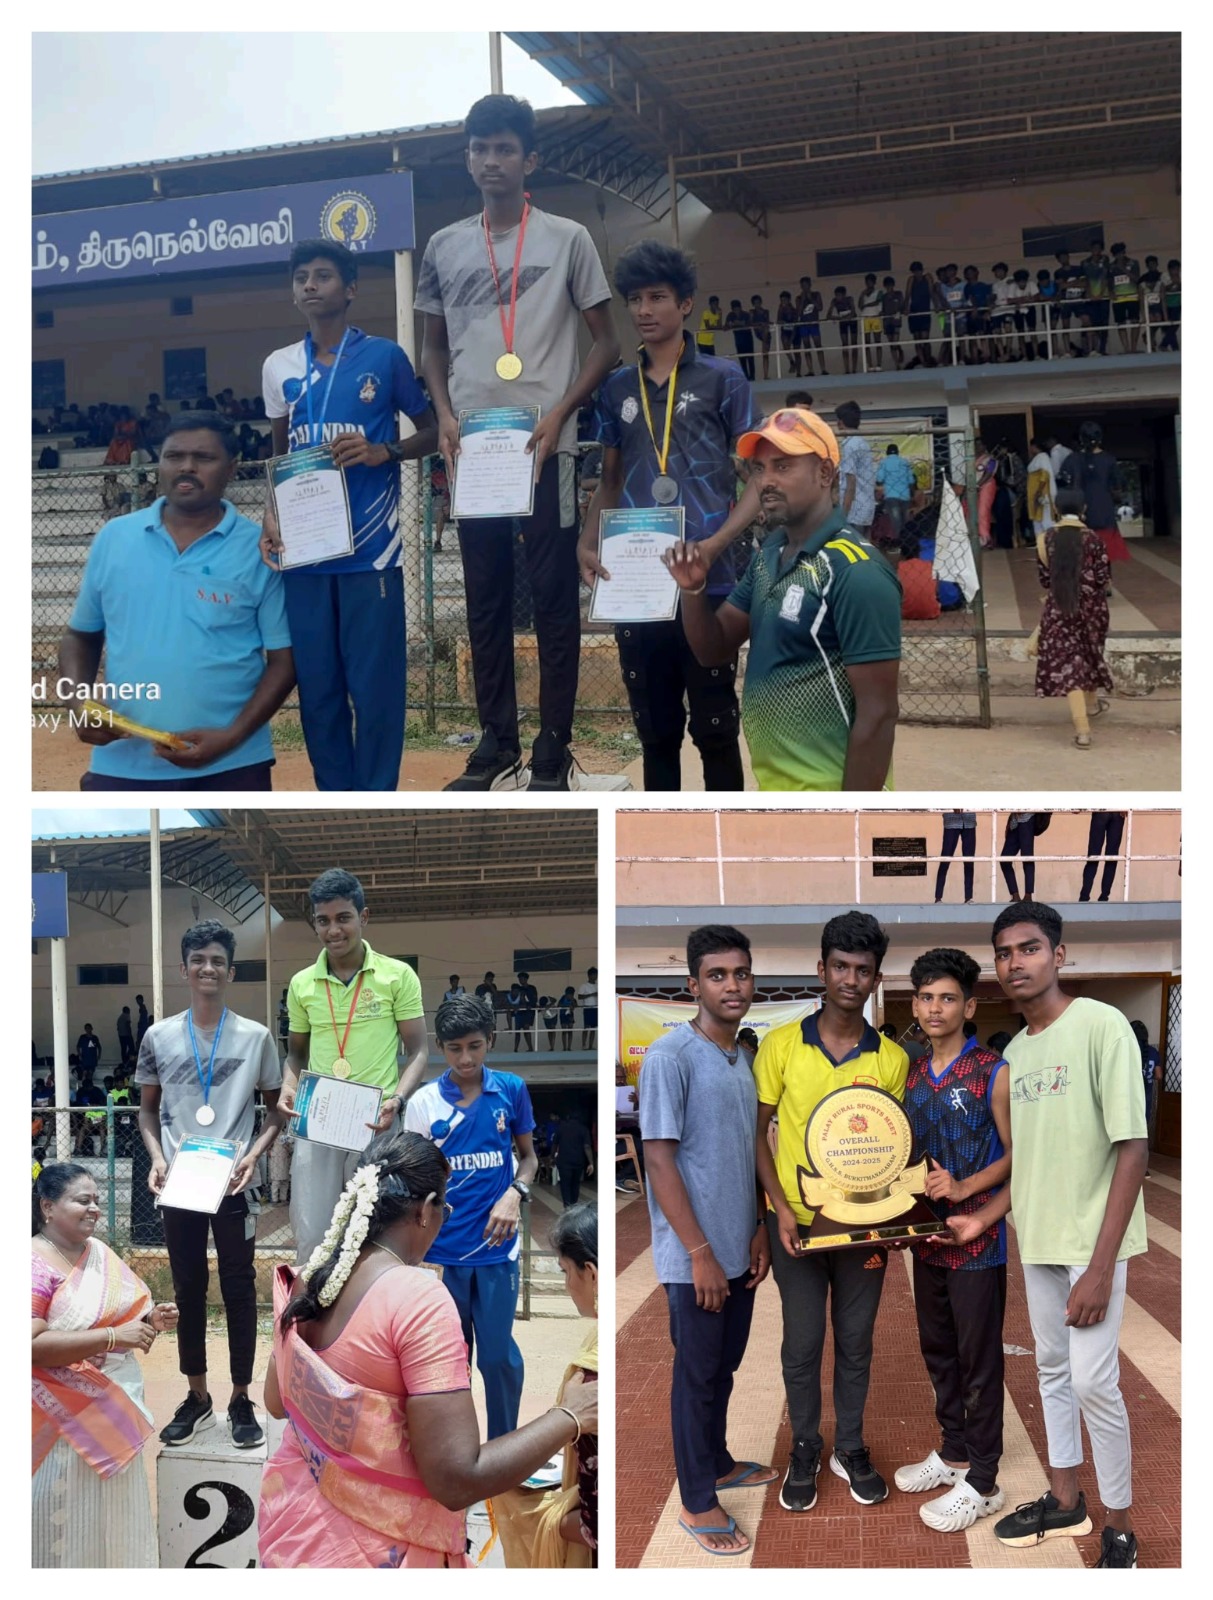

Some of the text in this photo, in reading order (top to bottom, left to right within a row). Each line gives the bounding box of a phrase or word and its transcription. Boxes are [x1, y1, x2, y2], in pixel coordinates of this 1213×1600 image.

[76, 207, 293, 274] திருநெல்வேலி
[822, 1104, 898, 1141] PALAY RURAL SPORTS MEET
[839, 1136, 880, 1146] OVERALL
[446, 1150, 504, 1170] RYENDRA
[826, 1146, 895, 1157] CHAMPIONSHIP
[842, 1158, 881, 1166] 2024-2025
[183, 1481, 256, 1568] 2
